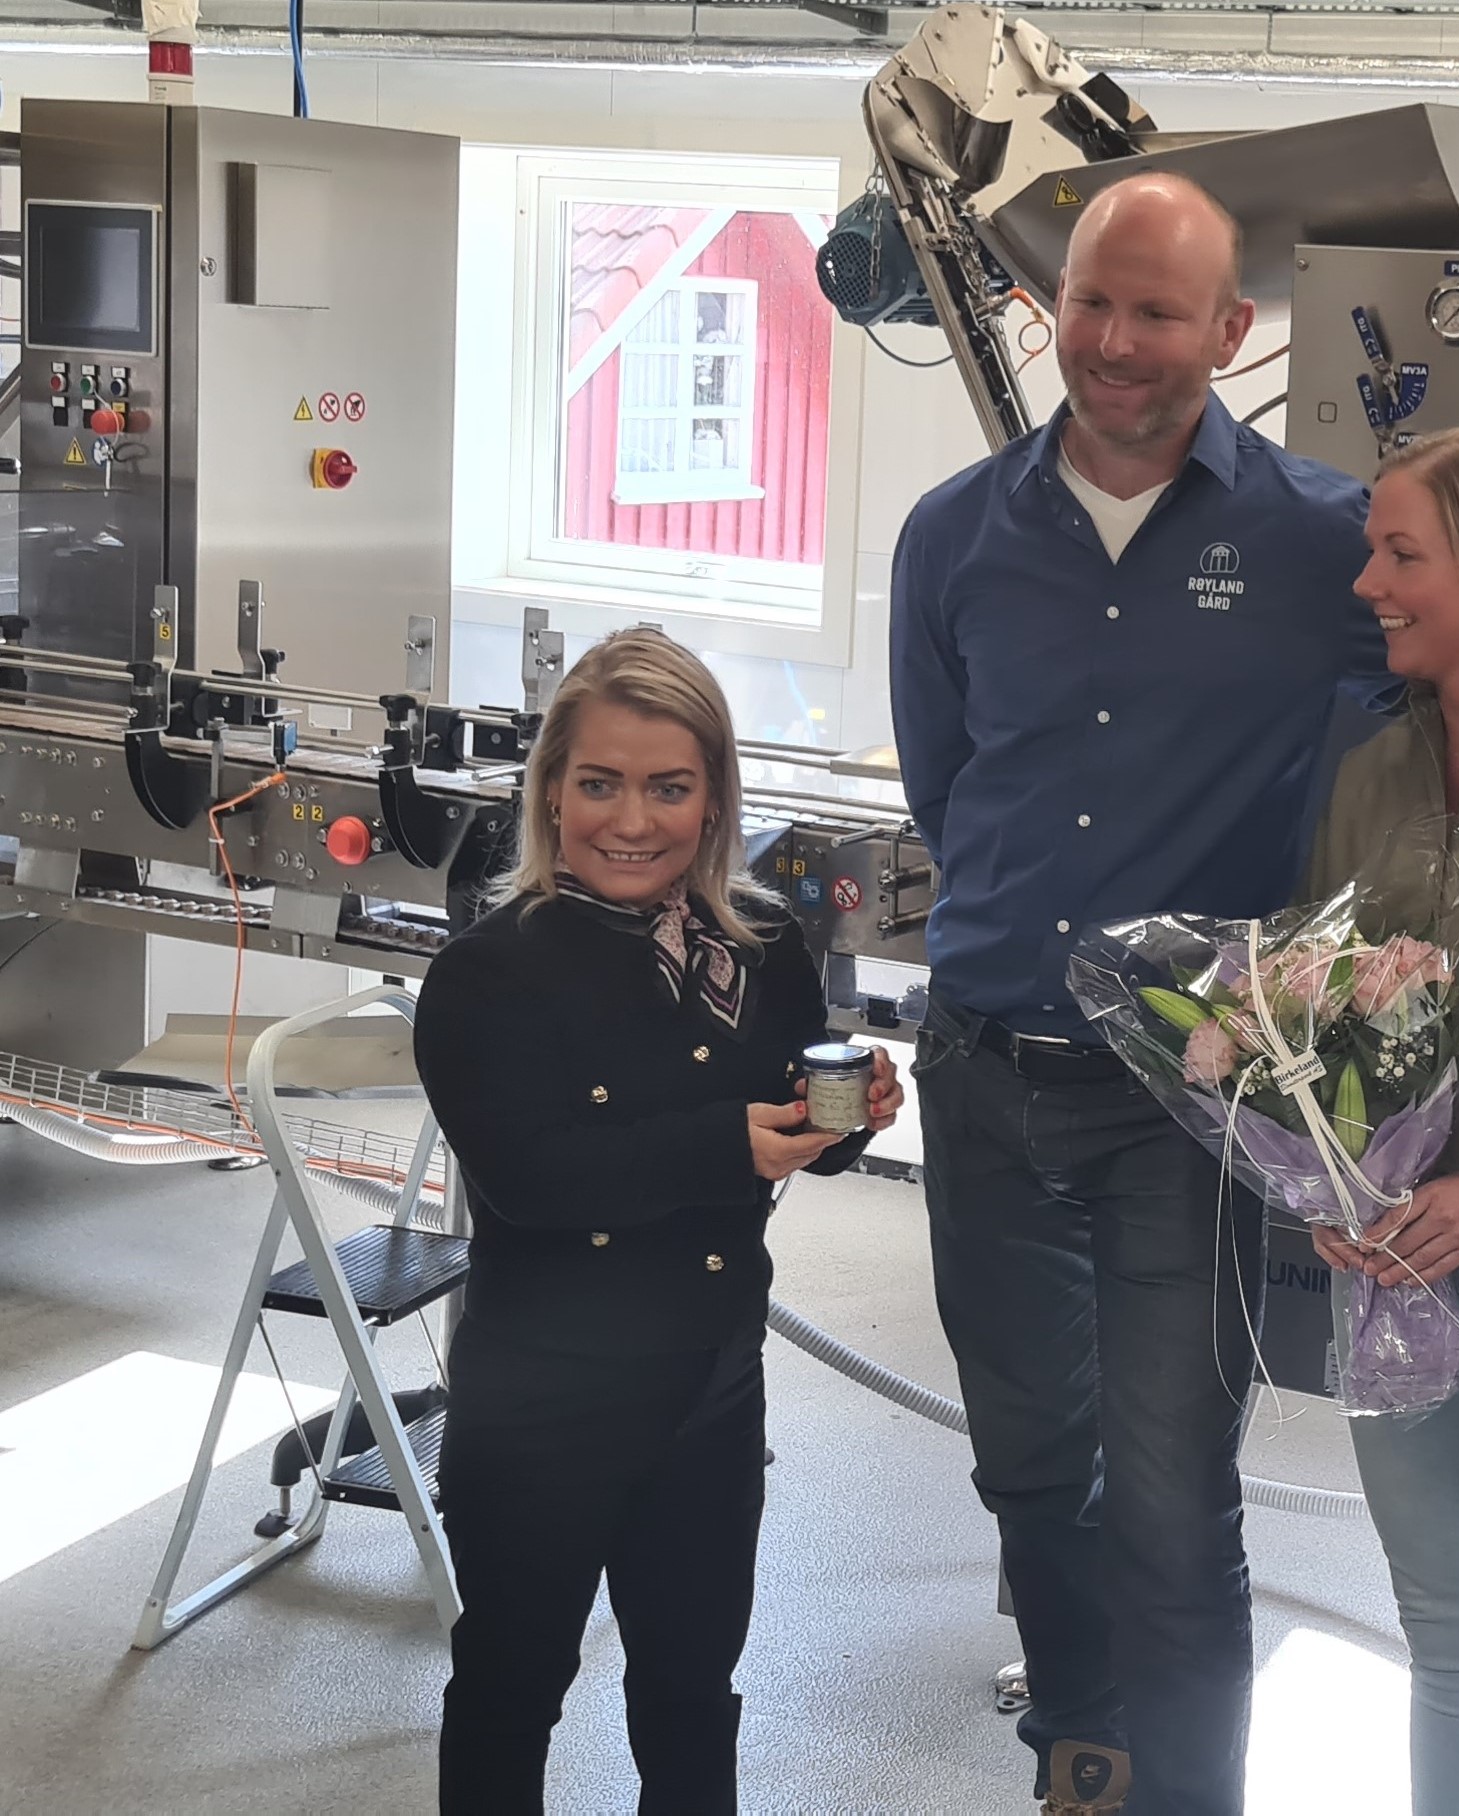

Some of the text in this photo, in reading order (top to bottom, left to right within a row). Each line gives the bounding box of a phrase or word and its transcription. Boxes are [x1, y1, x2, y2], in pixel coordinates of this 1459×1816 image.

[1402, 366, 1427, 375] MV3A
[1188, 577, 1244, 595] RØYLAND
[1198, 592, 1231, 610] GÅRD
[162, 626, 169, 638] 5
[295, 805, 303, 818] 2
[314, 807, 322, 819] 2
[794, 861, 803, 874] 3
[1275, 1055, 1320, 1085] Birkeland
